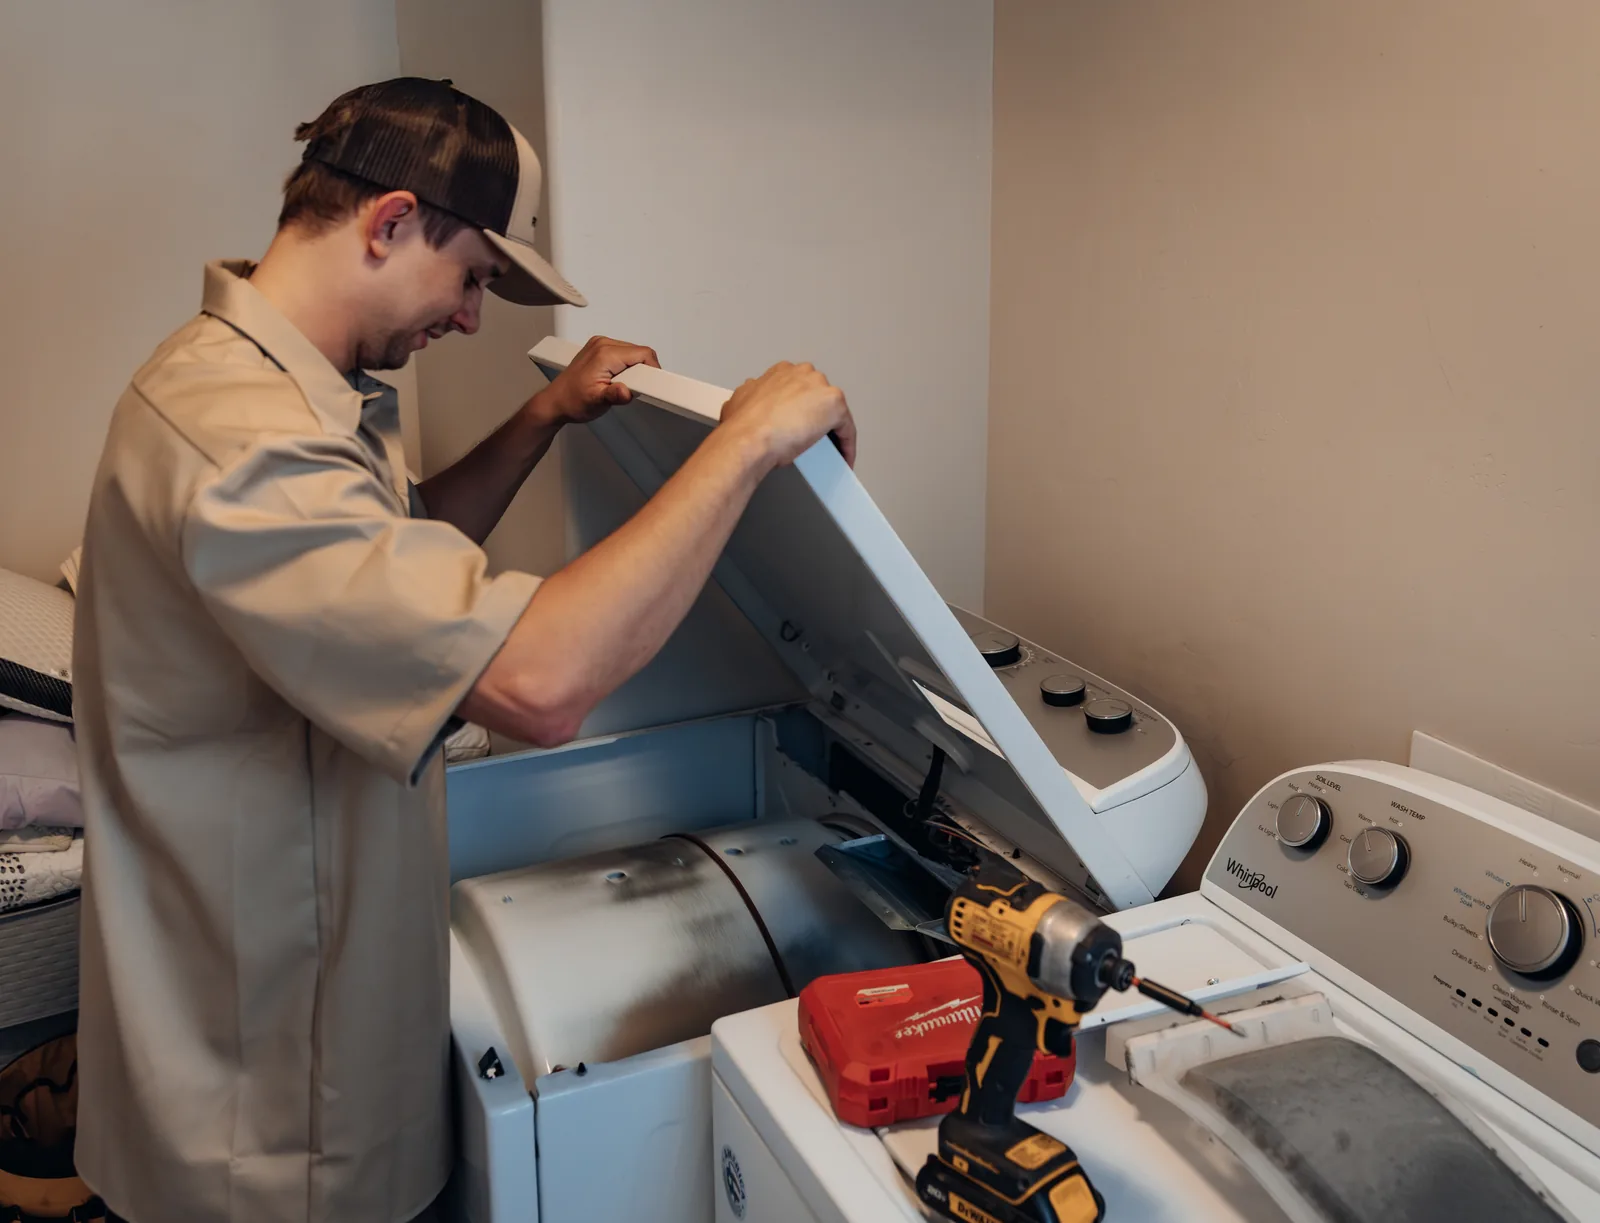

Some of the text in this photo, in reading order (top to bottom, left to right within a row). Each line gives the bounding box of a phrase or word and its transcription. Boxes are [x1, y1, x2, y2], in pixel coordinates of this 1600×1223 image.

[1315, 775, 1341, 792] SOIL LEVEL
[1390, 800, 1426, 821] WASH TEMP
[1358, 813, 1372, 824] Warm
[1336, 864, 1348, 874] Cold
[1518, 858, 1537, 871] Heavy
[1557, 864, 1582, 880] Normal
[1226, 857, 1278, 898] Whirlpool
[1451, 949, 1468, 963] Drain
[1473, 962, 1487, 973] Spin
[1575, 987, 1593, 1002] Quick
[1565, 1014, 1581, 1027] Spin
